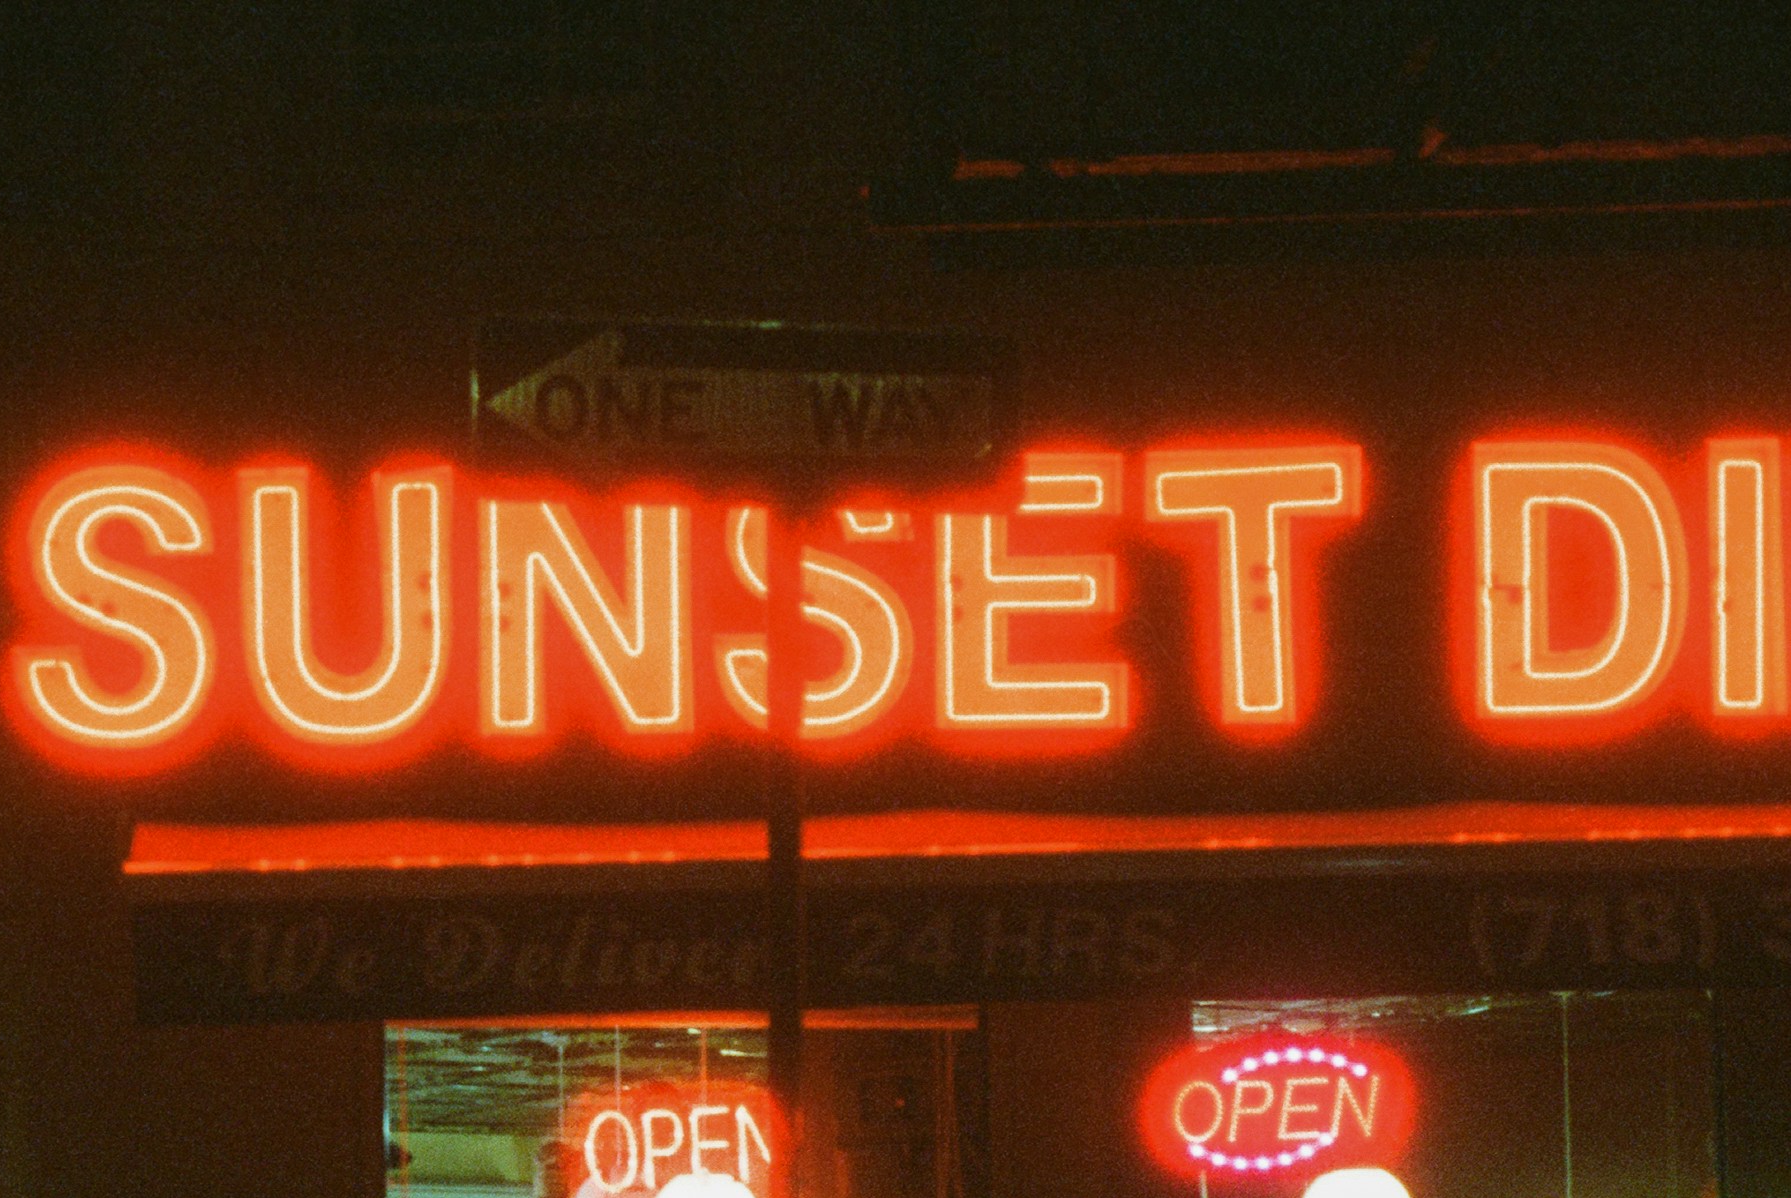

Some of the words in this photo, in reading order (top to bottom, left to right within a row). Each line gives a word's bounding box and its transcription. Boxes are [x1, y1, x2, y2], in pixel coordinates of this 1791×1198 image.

[536, 374, 705, 441] ONE
[9, 446, 1362, 746] SUNSET
[842, 911, 958, 978] 24
[1469, 892, 1713, 975] (718)
[584, 1105, 771, 1194] OPEN
[1173, 1074, 1381, 1143] OPEN
